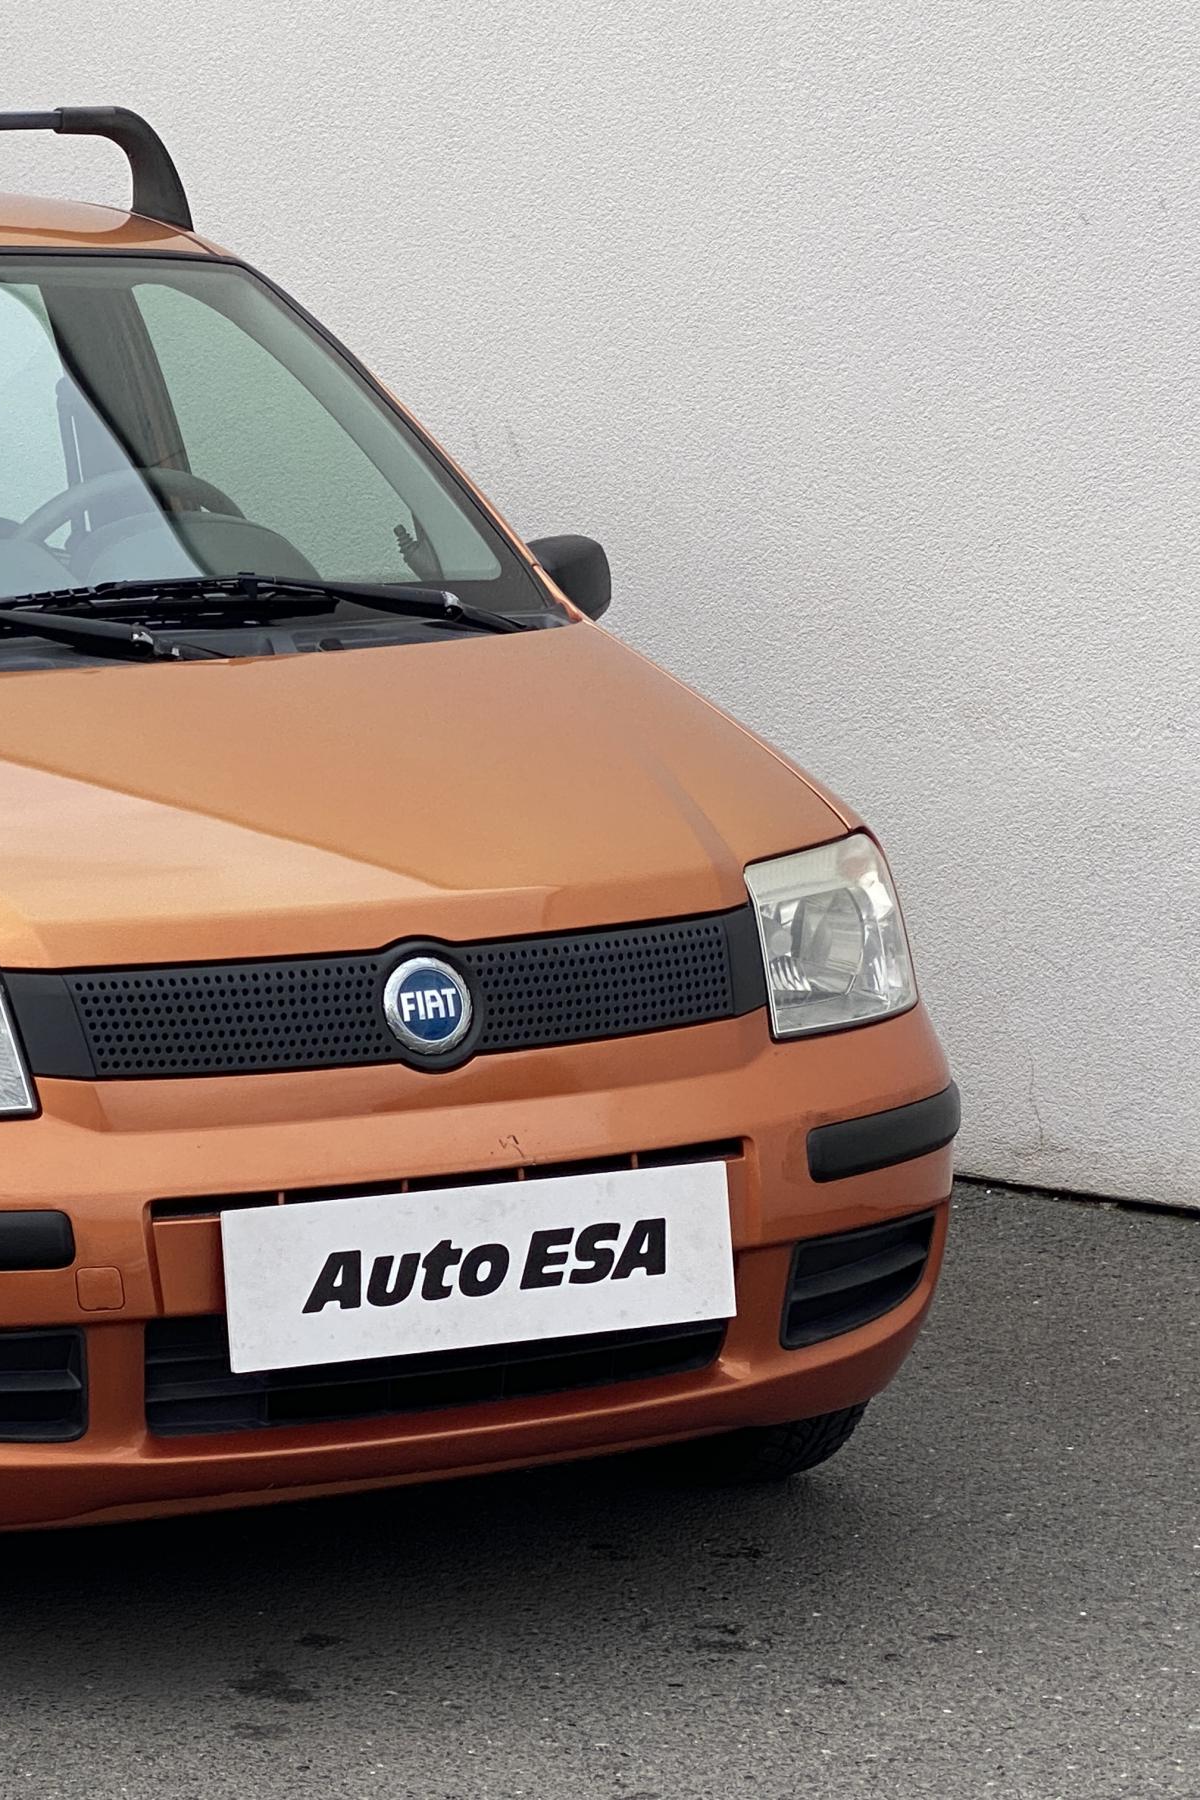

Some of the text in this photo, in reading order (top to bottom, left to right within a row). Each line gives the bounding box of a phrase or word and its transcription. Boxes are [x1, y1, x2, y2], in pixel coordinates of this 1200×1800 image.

[400, 988, 456, 1022] FIAT
[302, 1218, 666, 1313] Auto ESA
